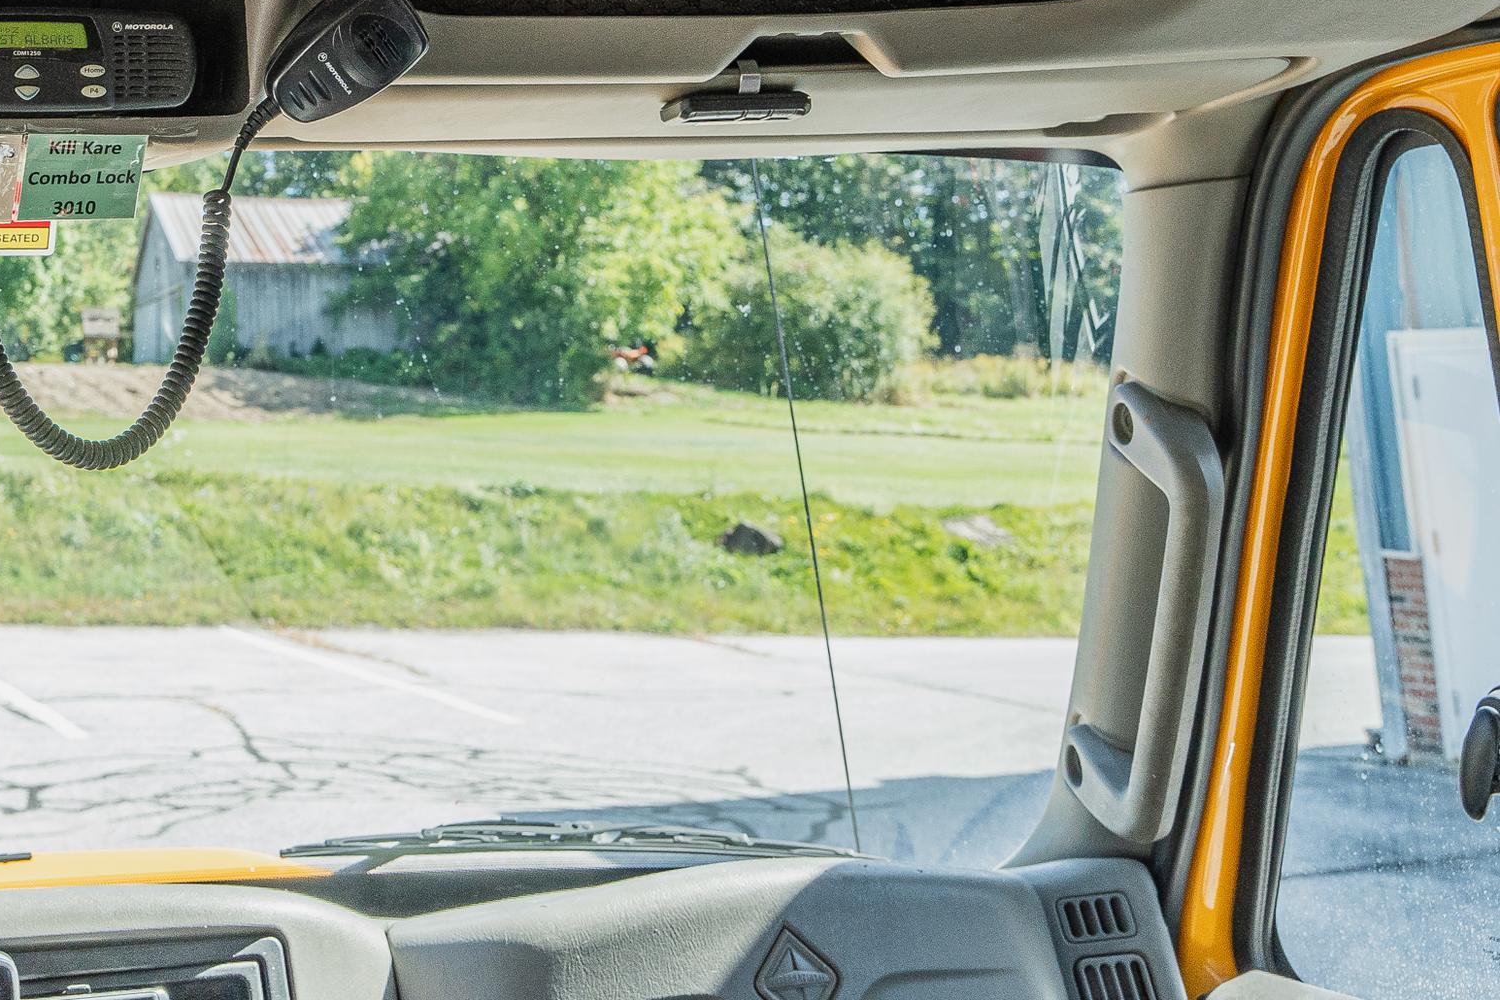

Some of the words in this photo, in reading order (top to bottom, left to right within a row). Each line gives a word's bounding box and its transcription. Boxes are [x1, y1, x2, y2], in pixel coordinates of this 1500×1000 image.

[124, 23, 174, 31] MOTOROLA
[84, 66, 105, 74] Home
[325, 61, 352, 95] MOTOROLA
[89, 86, 99, 94] P4
[49, 140, 77, 155] Kill
[82, 141, 122, 155] Kare
[28, 170, 91, 185] Combo
[96, 170, 136, 184] Lock
[52, 200, 96, 215] 3010
